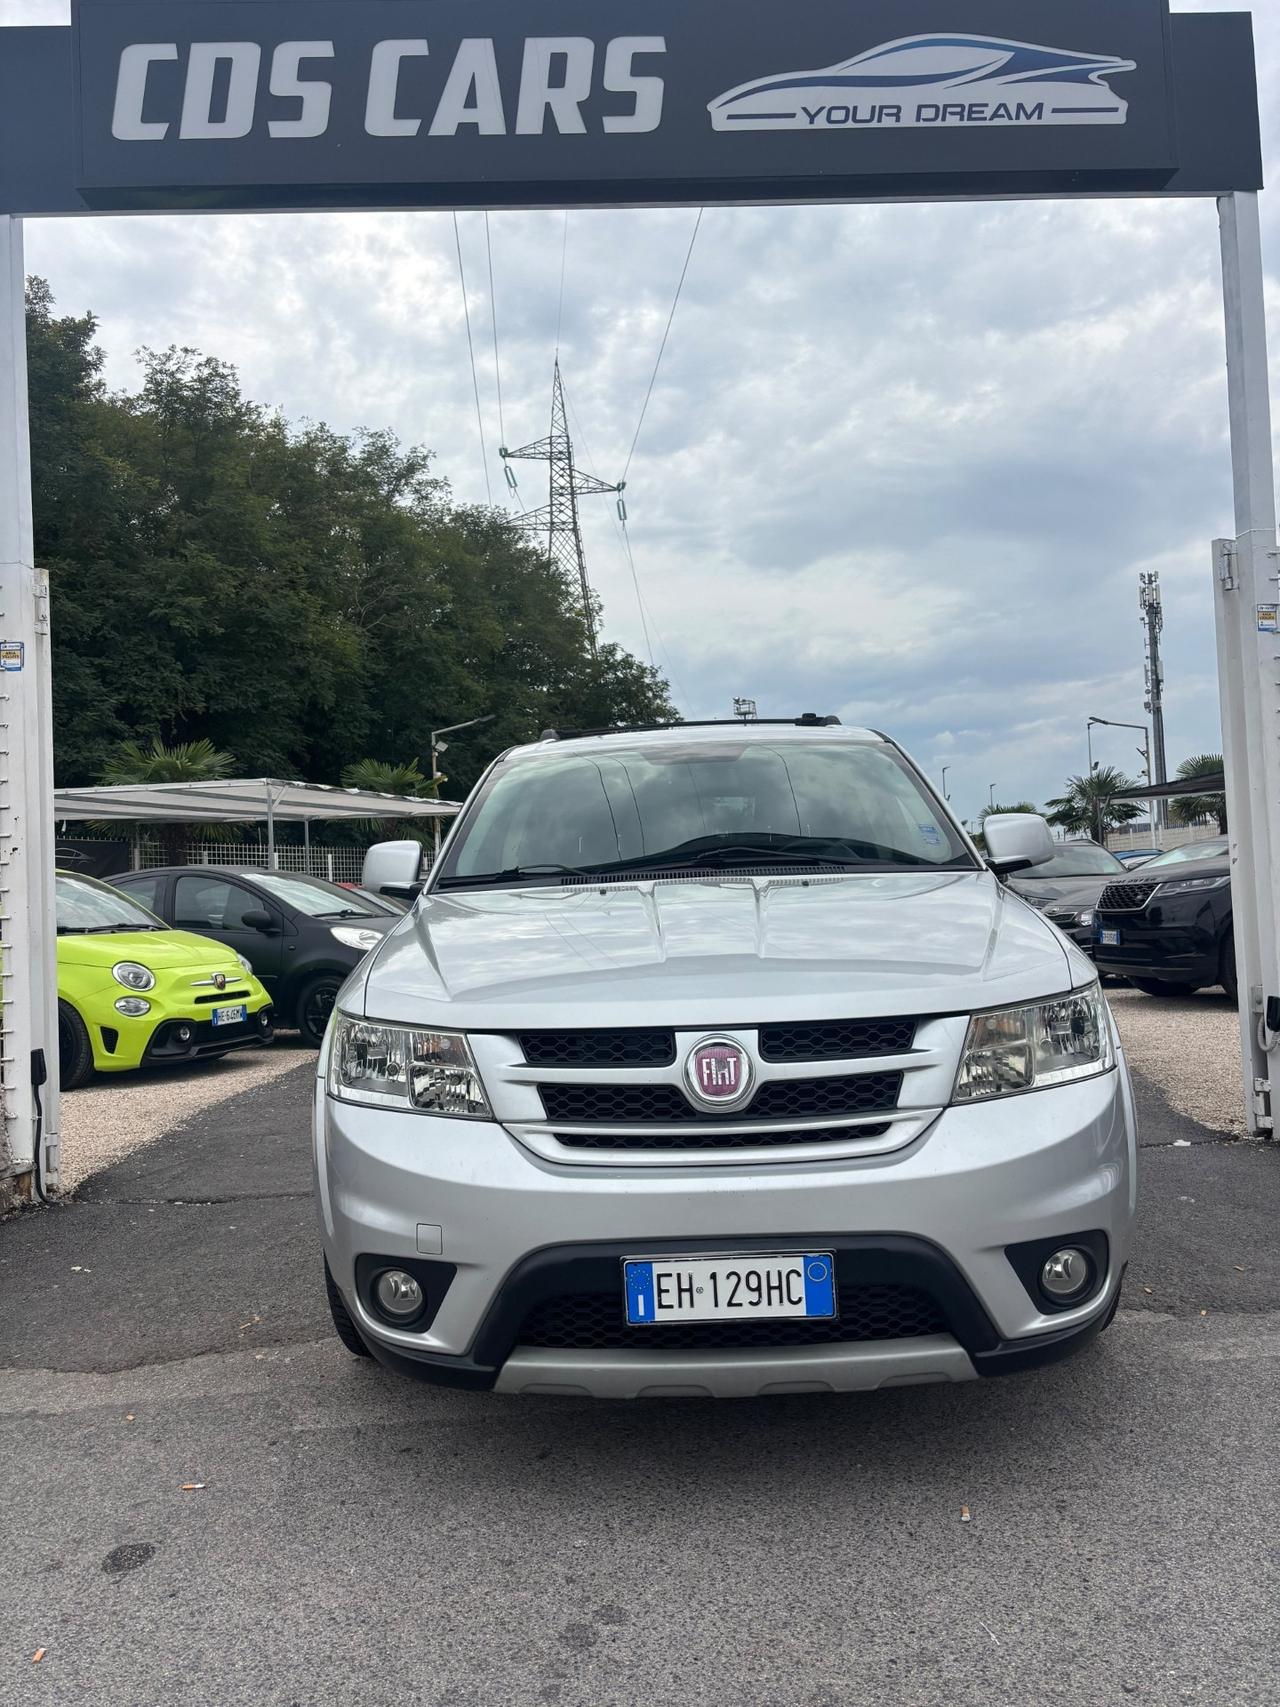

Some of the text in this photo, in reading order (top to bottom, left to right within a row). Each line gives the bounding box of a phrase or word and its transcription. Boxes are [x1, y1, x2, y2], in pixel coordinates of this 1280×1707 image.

[111, 36, 667, 141] CDS CARS
[801, 102, 1044, 125] YOUR DREAM
[702, 1057, 737, 1086] FIAT
[656, 1269, 804, 1309] EH 129HC
